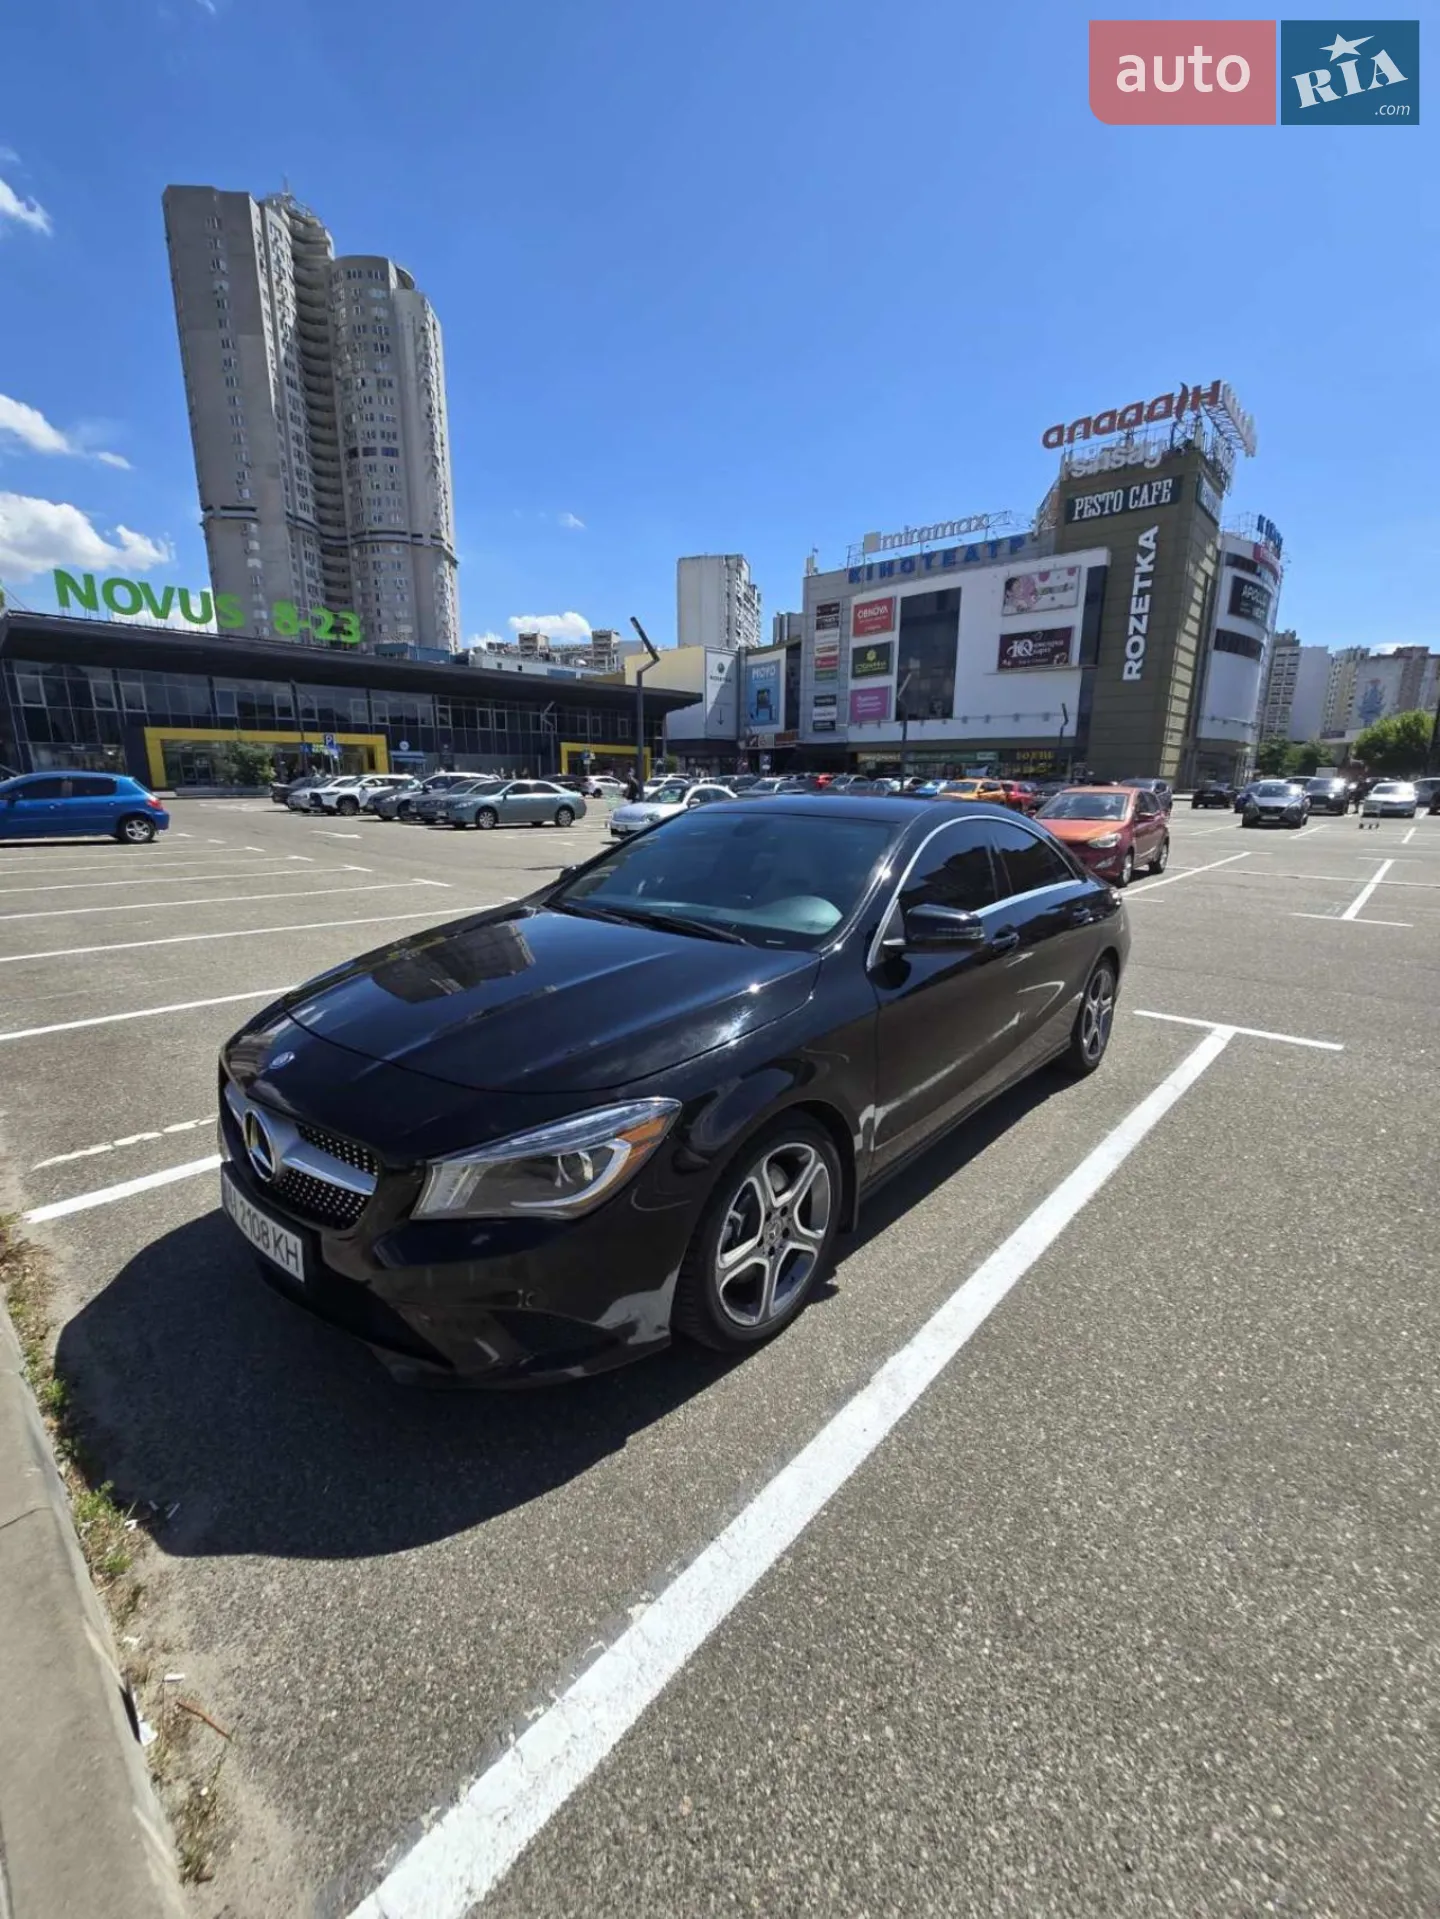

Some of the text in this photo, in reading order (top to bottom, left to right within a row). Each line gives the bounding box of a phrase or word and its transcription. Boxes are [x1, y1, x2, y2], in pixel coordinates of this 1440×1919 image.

[881, 513, 989, 550] miramax
[1072, 489, 1124, 521] PESTO
[1128, 478, 1173, 510] CAFE
[53, 568, 361, 644] NOVUS 8-23
[1122, 525, 1160, 681] ROZETKA
[240, 1199, 270, 1250] 2108
[271, 1225, 299, 1273] KH
